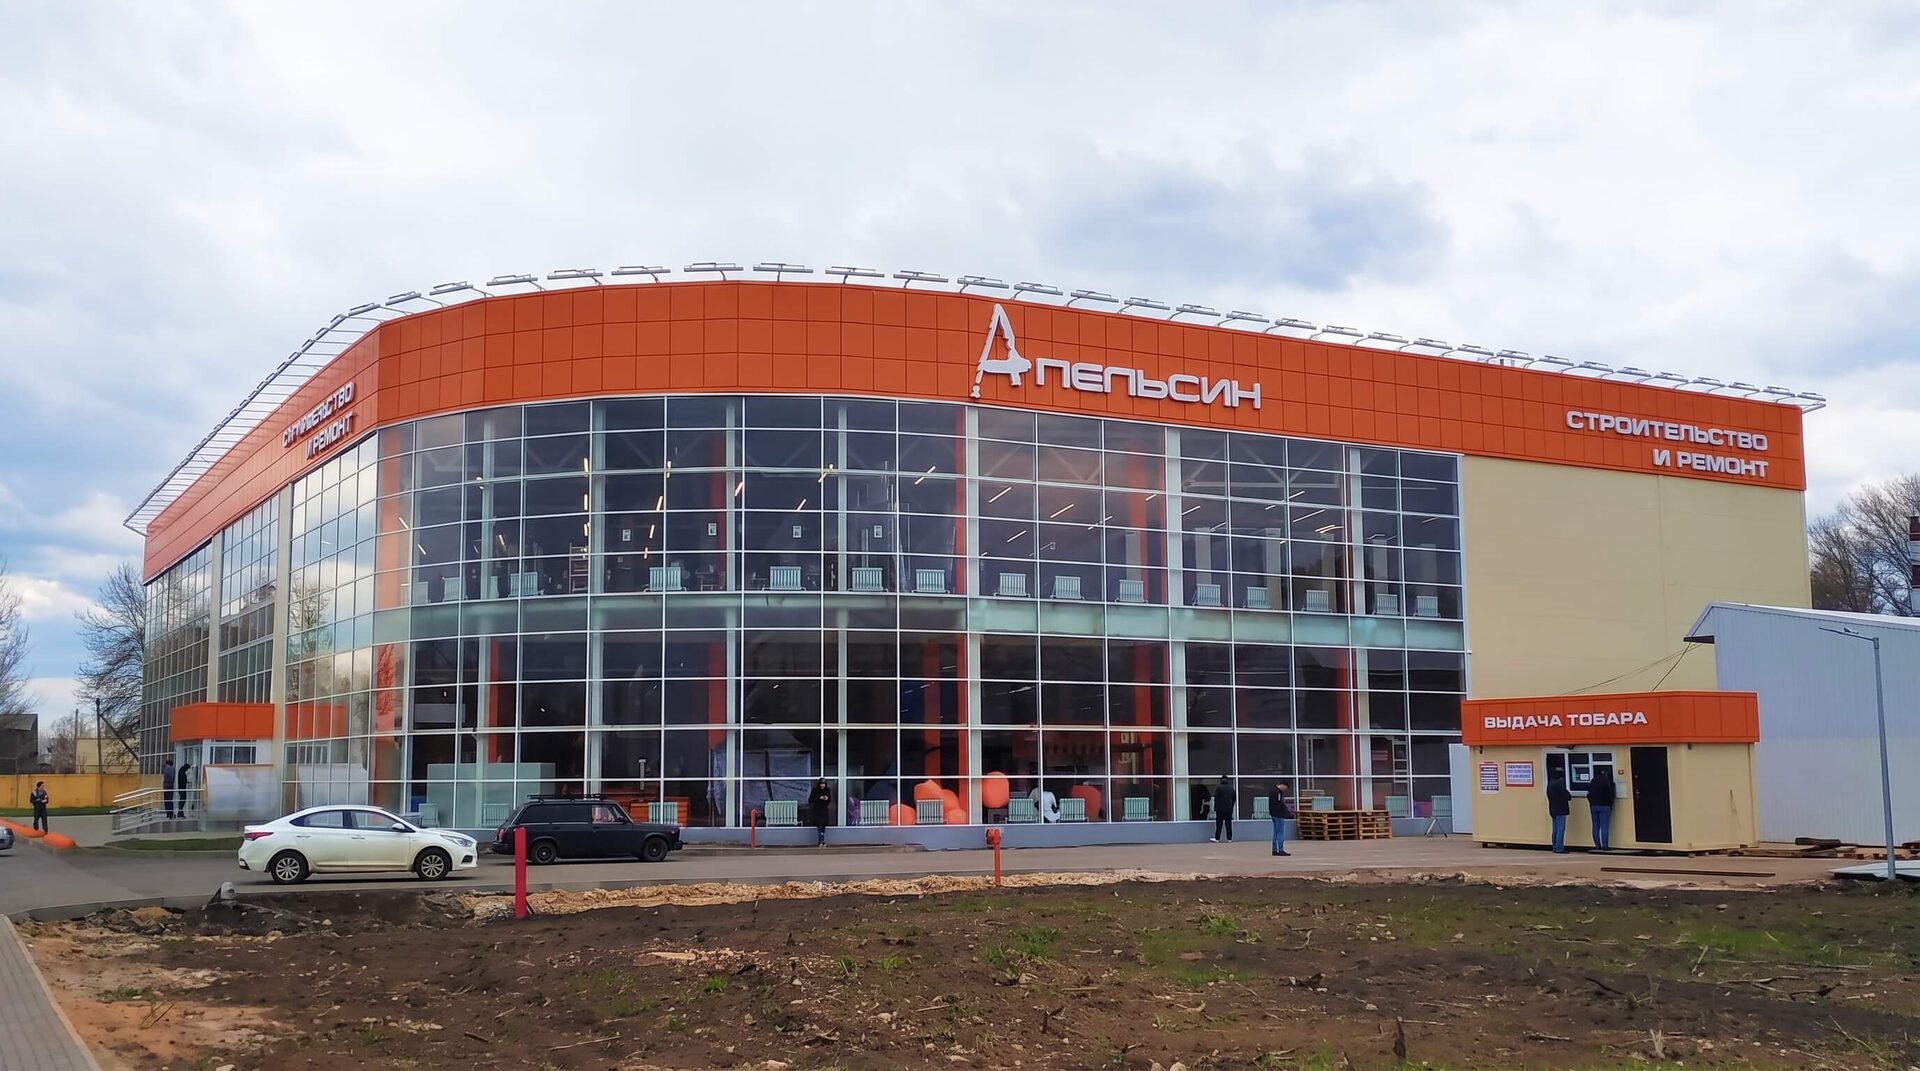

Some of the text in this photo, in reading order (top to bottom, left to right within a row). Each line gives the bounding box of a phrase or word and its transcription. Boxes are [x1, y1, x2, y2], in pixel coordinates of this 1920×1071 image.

[312, 412, 353, 453] РЕМОНТ
[1566, 411, 1768, 451] СТРОИТЕЛЬСТВО
[1653, 449, 1768, 478] И РЕМОНТ
[1484, 714, 1563, 730] ВЫДАЧА
